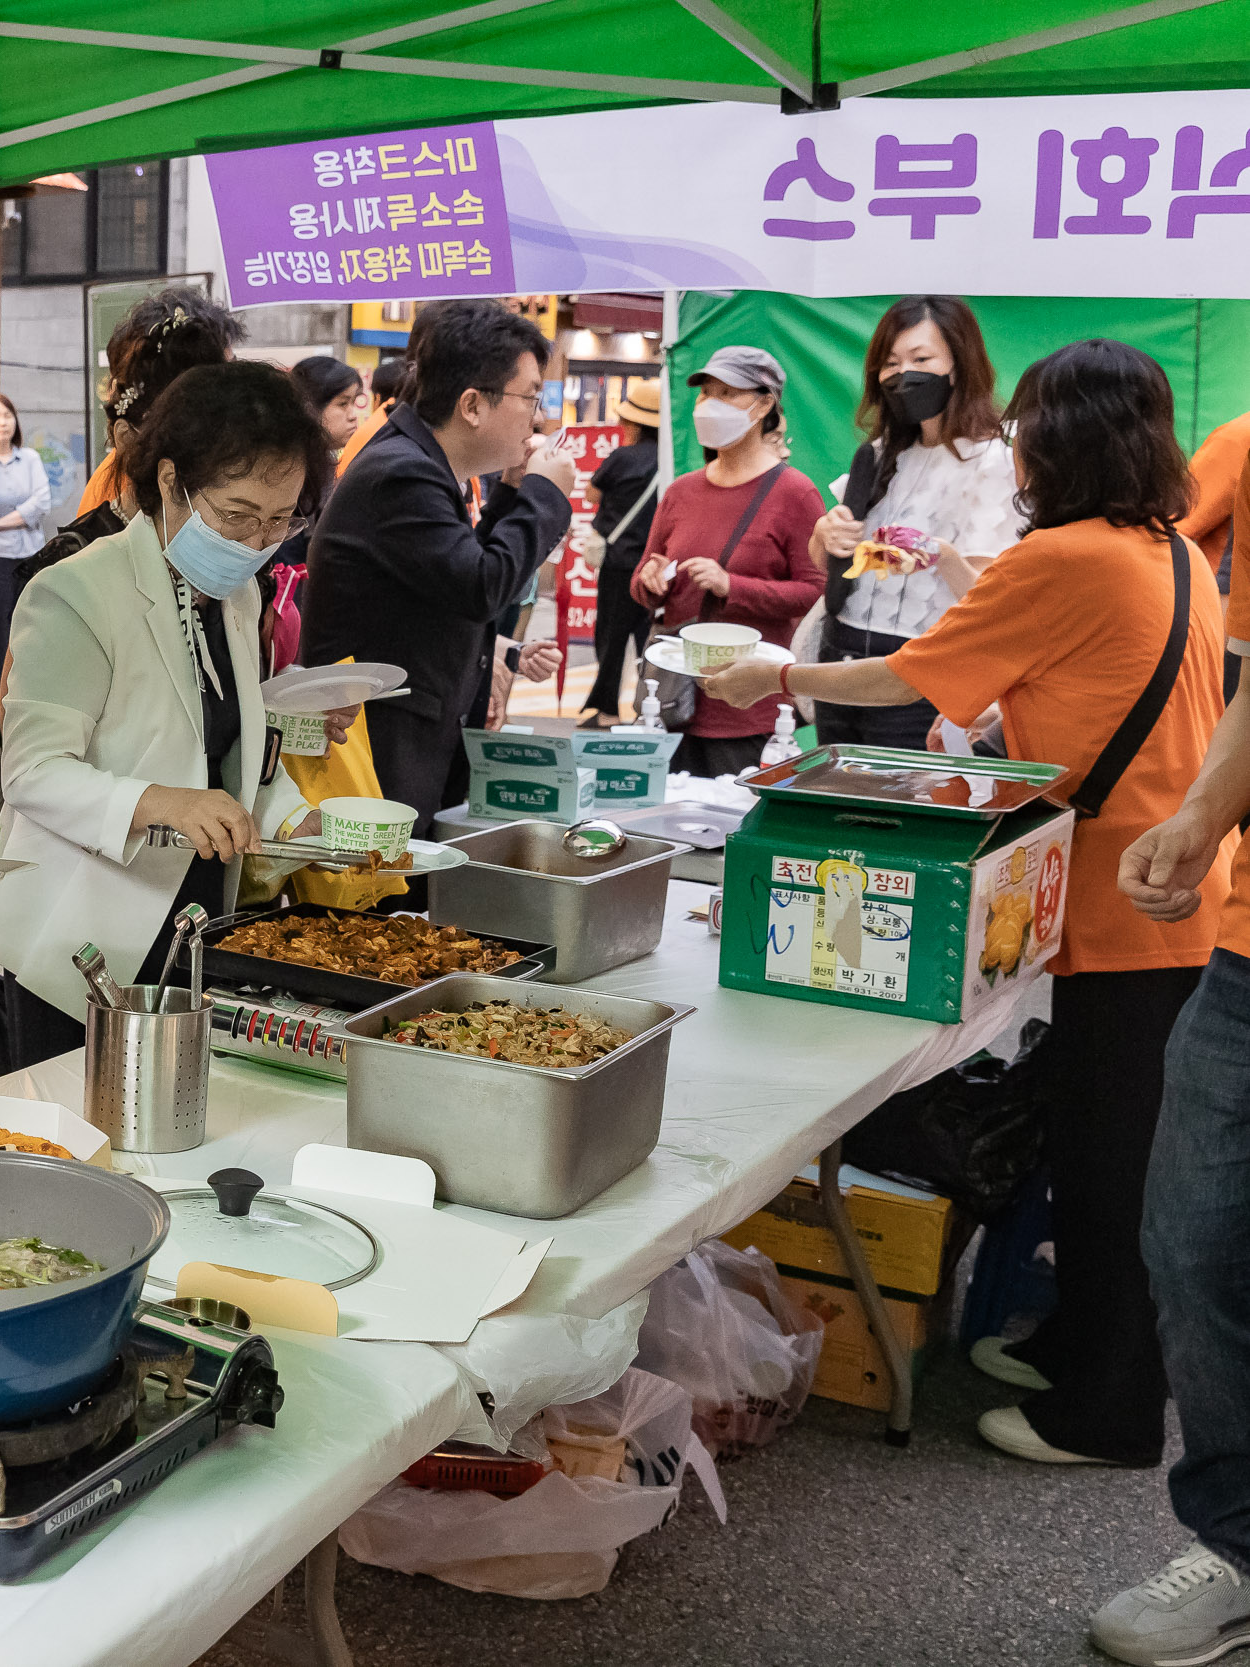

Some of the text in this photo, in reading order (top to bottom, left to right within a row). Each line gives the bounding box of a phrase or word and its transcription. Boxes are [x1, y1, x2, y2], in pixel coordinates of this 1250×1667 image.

[707, 646, 736, 657] ECO
[300, 718, 324, 728] MAK
[334, 817, 370, 833] MAKE
[399, 820, 414, 836] EC
[334, 828, 370, 840] THE WORLD
[373, 831, 397, 839] GREEN
[334, 836, 340, 844] A
[340, 837, 369, 849] BETTER
[776, 861, 909, 895] 초전 참외
[895, 951, 906, 962] 개
[812, 966, 834, 977] 생산자
[853, 986, 905, 1000] 931-2007
